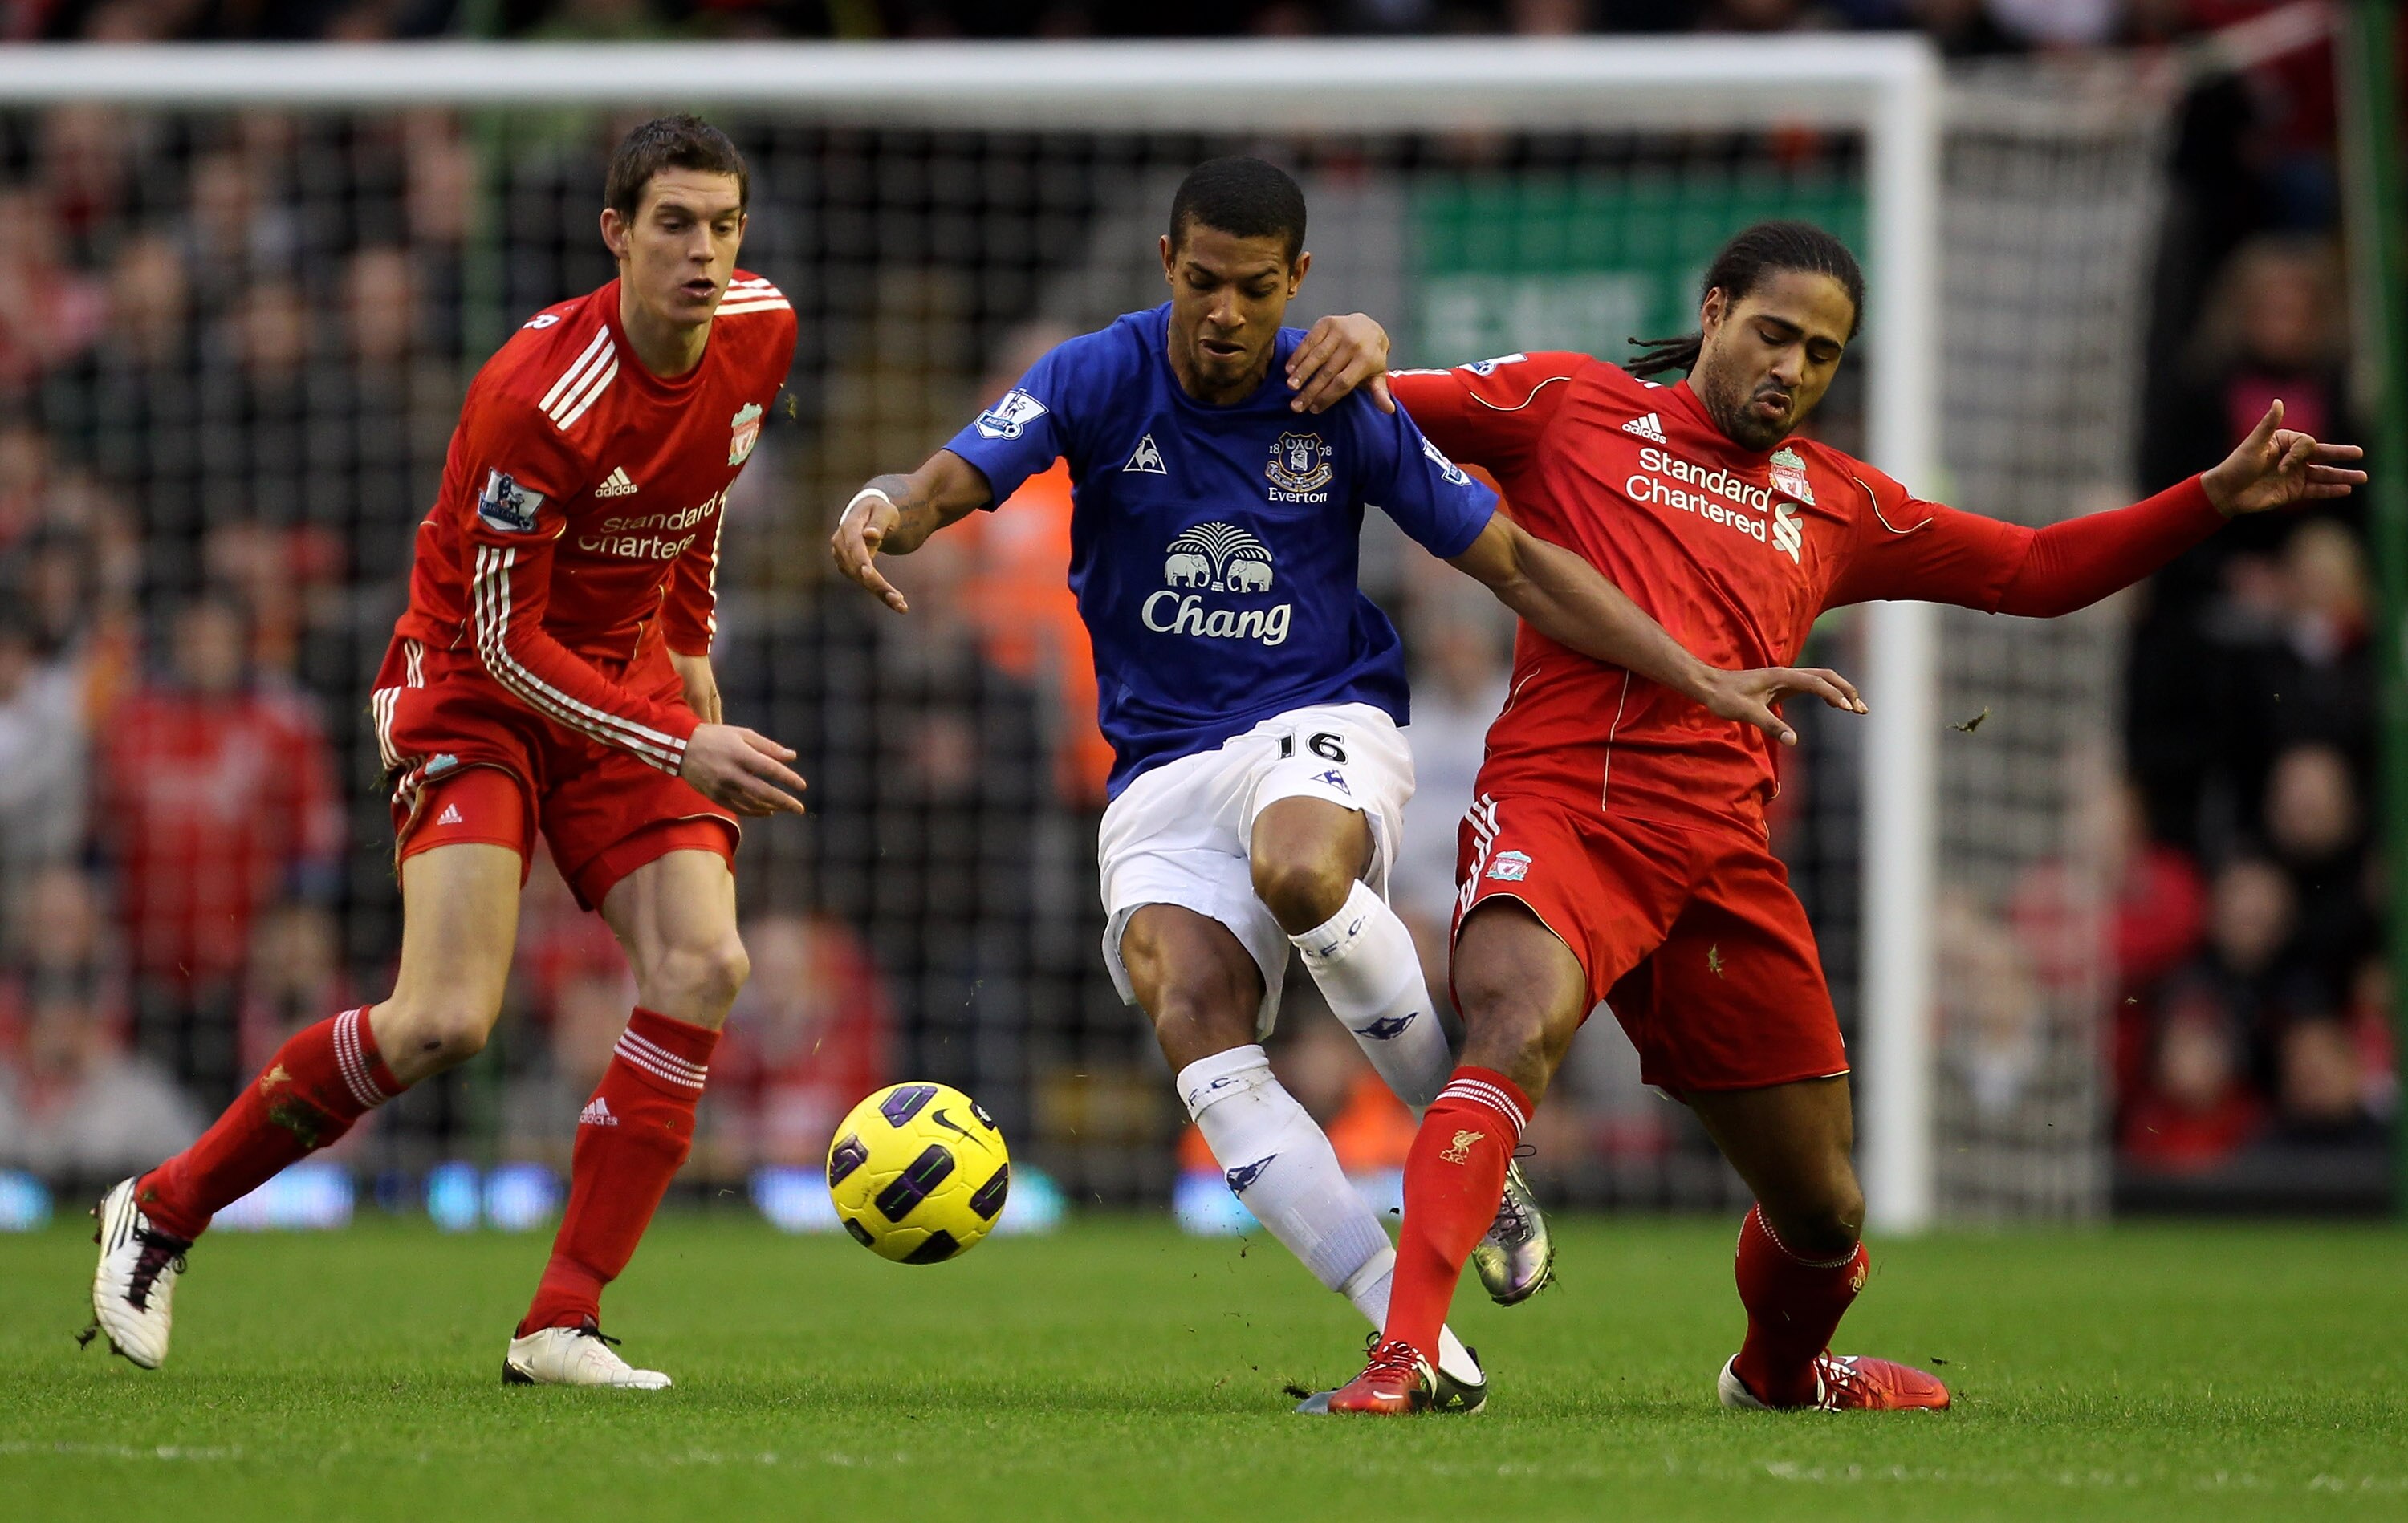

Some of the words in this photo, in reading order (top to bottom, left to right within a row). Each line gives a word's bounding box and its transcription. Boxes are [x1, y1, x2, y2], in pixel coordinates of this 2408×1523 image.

[1621, 423, 1667, 445] adidas
[1269, 443, 1280, 454] 18
[1319, 445, 1332, 457] 78
[595, 483, 638, 498] adidas
[1268, 486, 1328, 503] Everton
[1638, 447, 1773, 513] Standard
[600, 491, 719, 534] Standard
[1625, 475, 1767, 543] Chartered
[578, 532, 697, 560] Chartere
[1141, 590, 1291, 646] Chang
[1275, 731, 1349, 765] 16
